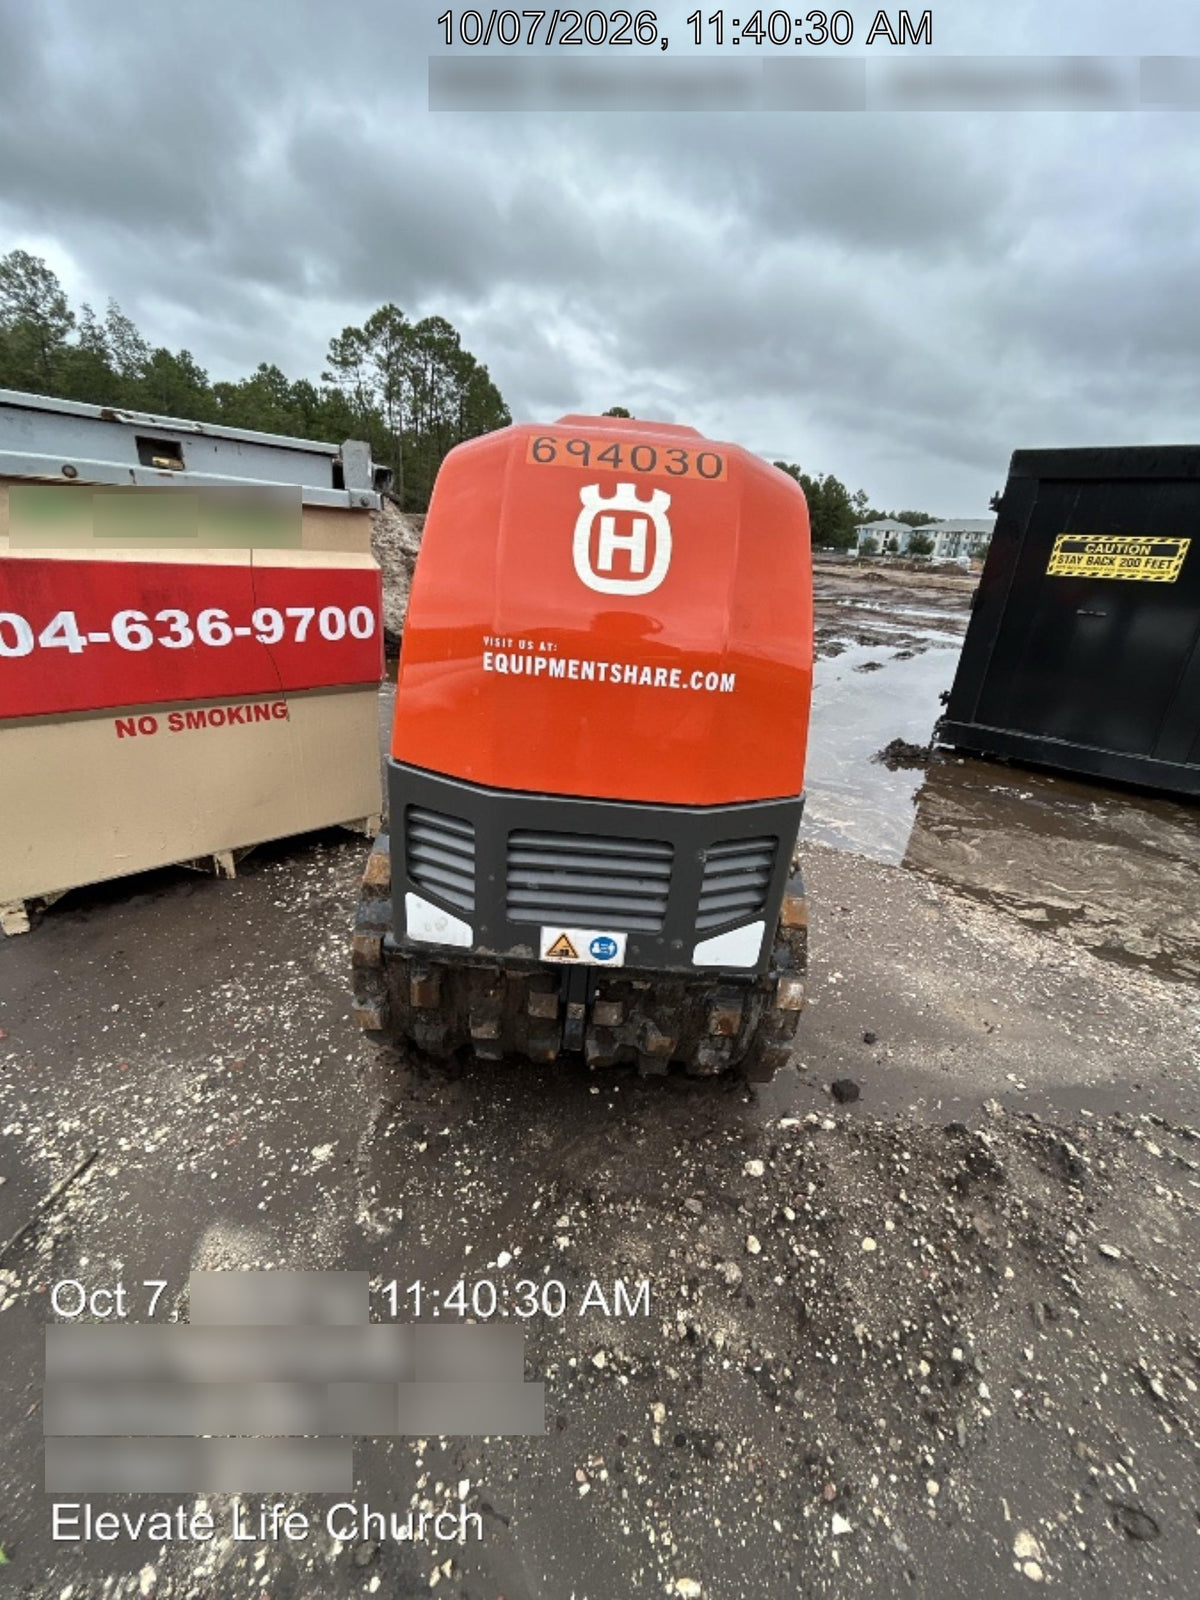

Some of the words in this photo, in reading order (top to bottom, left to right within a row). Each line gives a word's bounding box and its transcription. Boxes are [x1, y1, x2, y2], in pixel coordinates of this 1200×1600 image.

[532, 436, 723, 479] 694030
[1057, 555, 1083, 565] STAY
[1086, 556, 1115, 567] BACK
[1119, 557, 1141, 568] 200
[1144, 558, 1174, 570] FEET
[1084, 543, 1152, 556] CAUTION
[0, 606, 375, 657] 04-636-9700
[483, 635, 513, 648] VISIT
[518, 639, 534, 650] US
[539, 641, 558, 652] AT:
[483, 651, 736, 692] EQUIPMENTSHARE.COM
[115, 716, 158, 739] NO
[168, 702, 288, 733] SMOKING
